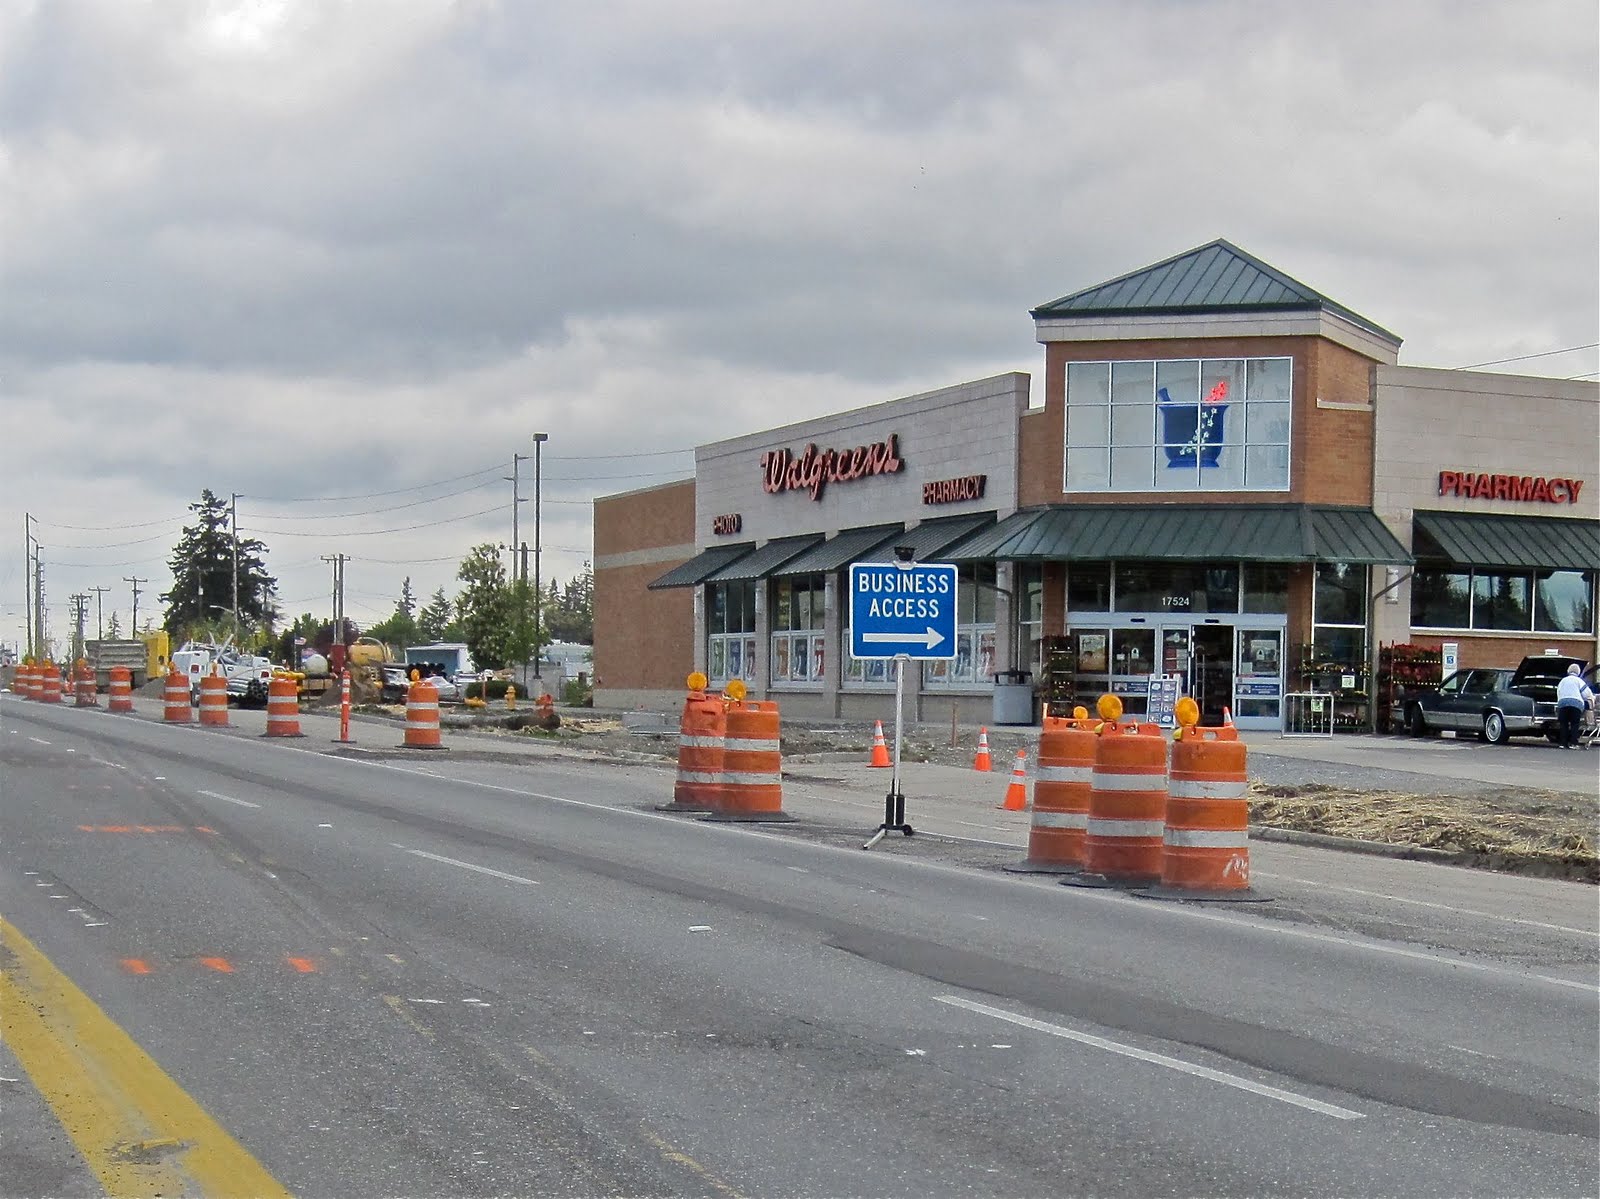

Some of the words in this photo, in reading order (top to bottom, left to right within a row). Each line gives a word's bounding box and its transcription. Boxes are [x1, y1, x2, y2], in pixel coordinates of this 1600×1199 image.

[760, 433, 905, 501] Walgreens
[923, 474, 986, 505] PHARMACY
[1438, 470, 1584, 505] PHARMACY
[713, 513, 742, 535] PHOTO
[859, 573, 949, 594] BUSINESS
[869, 598, 939, 618] ACCESS
[1162, 596, 1190, 606] 17524
